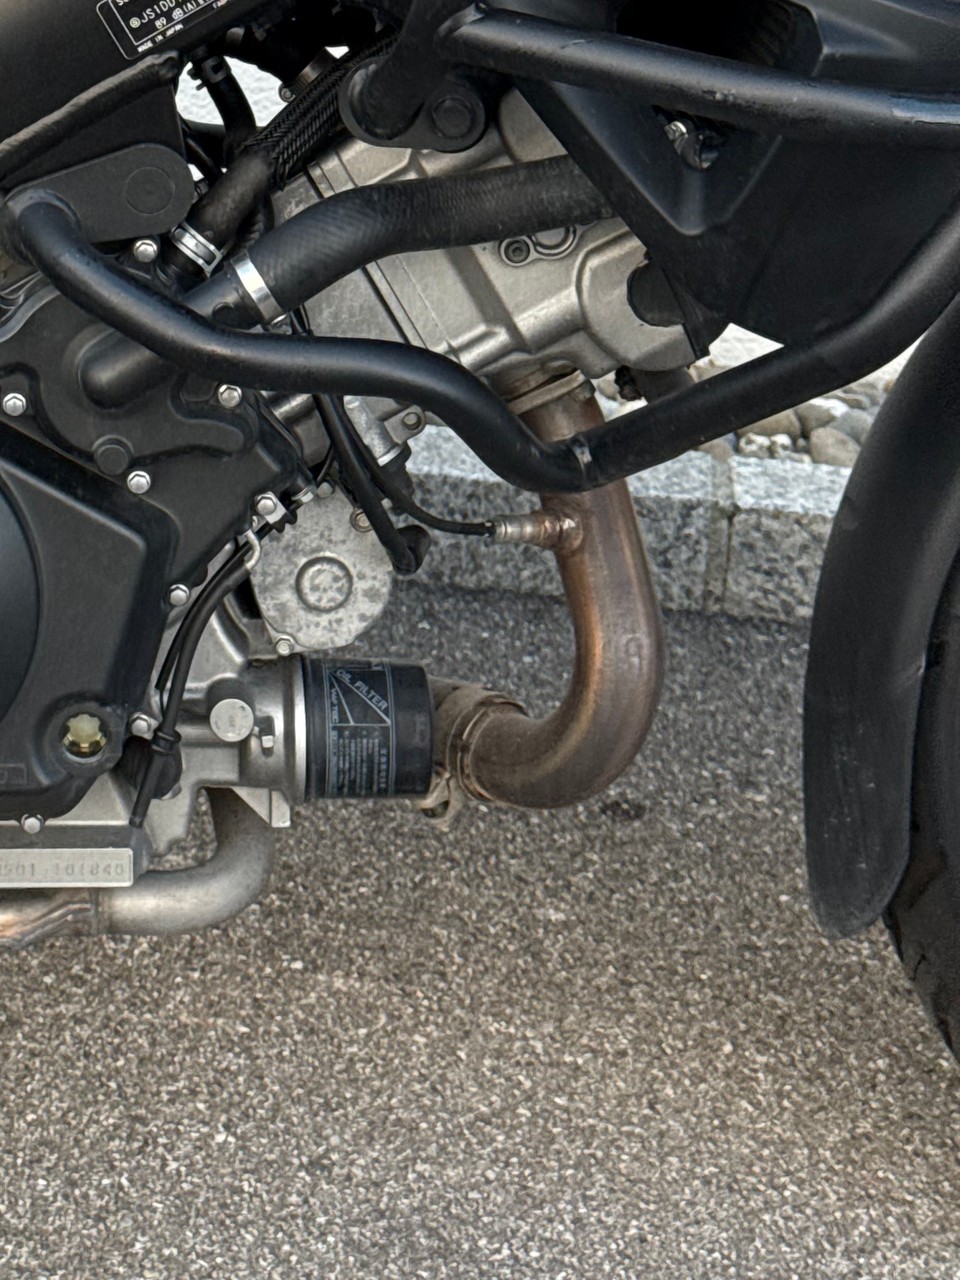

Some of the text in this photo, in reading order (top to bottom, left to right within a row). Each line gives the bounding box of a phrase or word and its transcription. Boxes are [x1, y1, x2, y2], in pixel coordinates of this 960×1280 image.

[155, 17, 167, 29] 89
[336, 669, 388, 711] OIL FILTER
